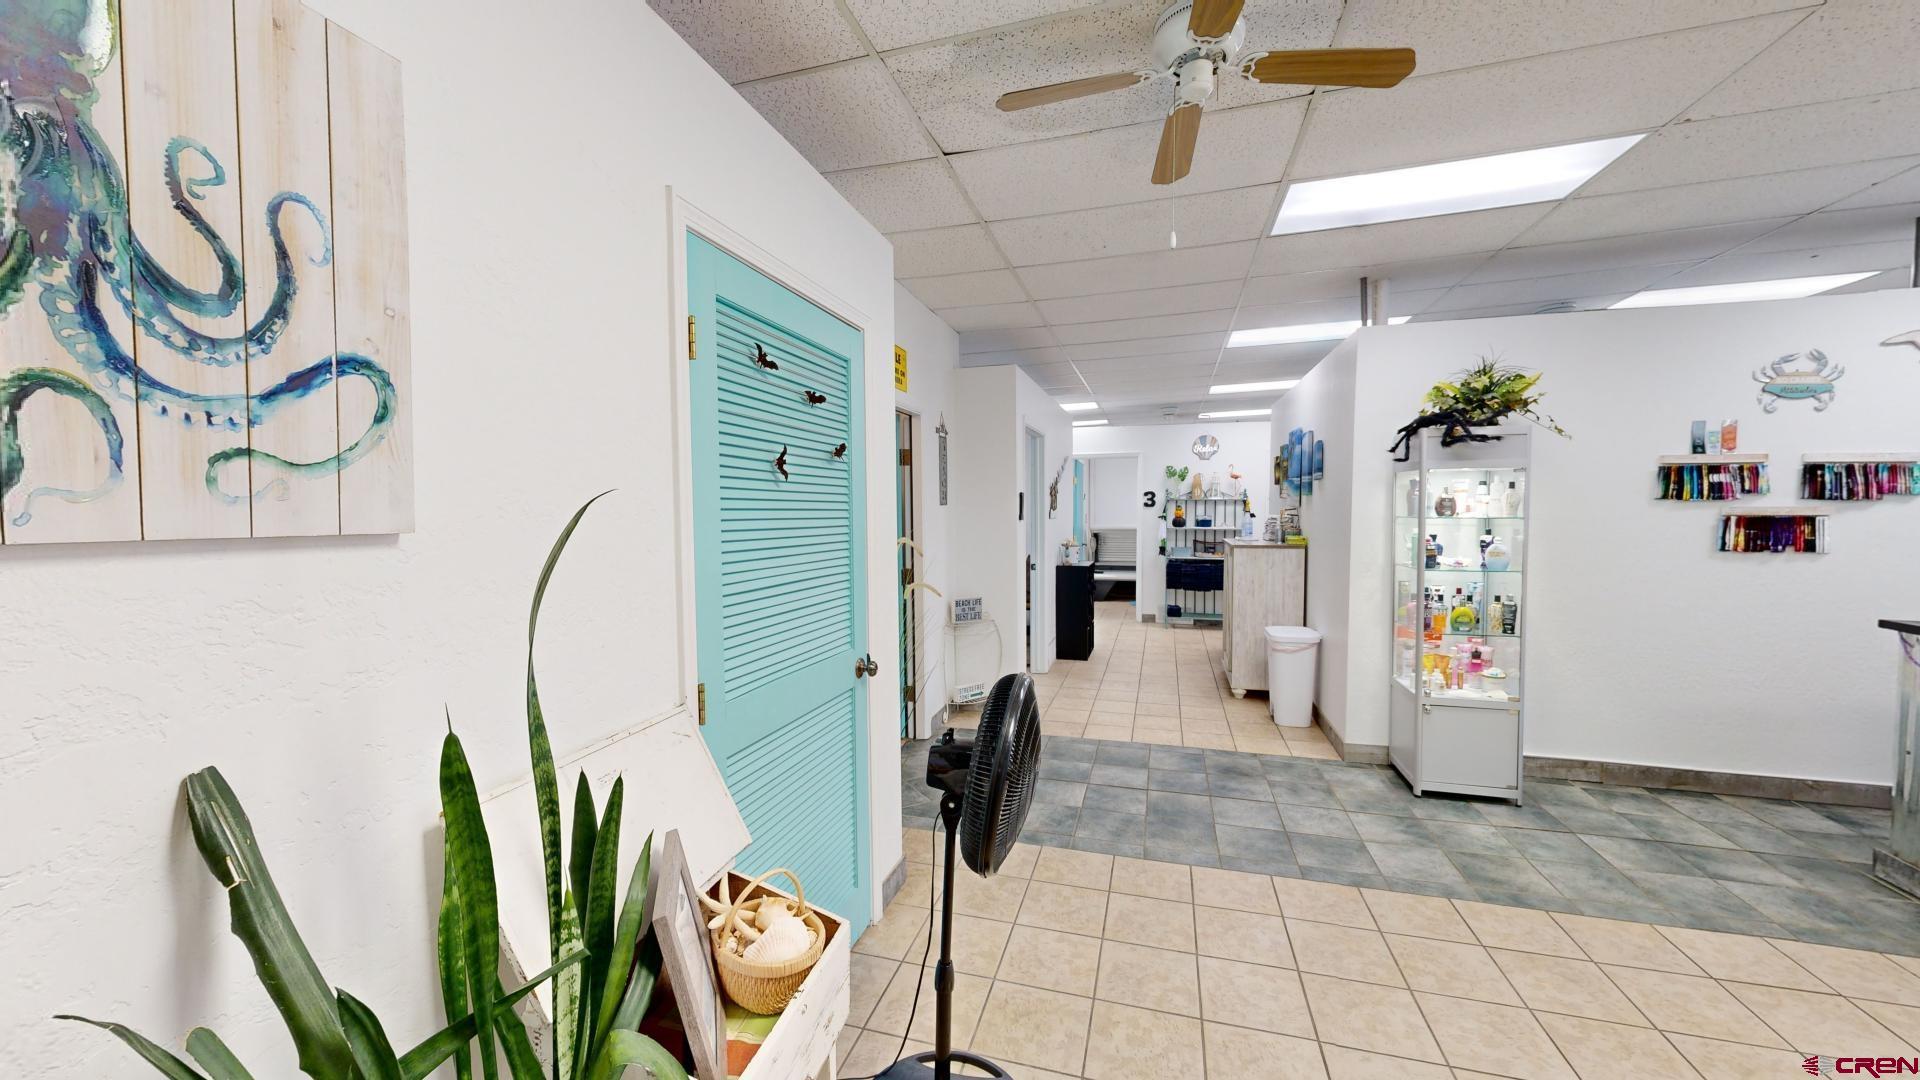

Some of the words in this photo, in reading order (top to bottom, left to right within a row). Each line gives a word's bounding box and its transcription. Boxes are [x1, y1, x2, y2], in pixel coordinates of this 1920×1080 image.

[1143, 491, 1156, 507] 3
[955, 613, 969, 621] BEST
[970, 612, 982, 620] LIFE
